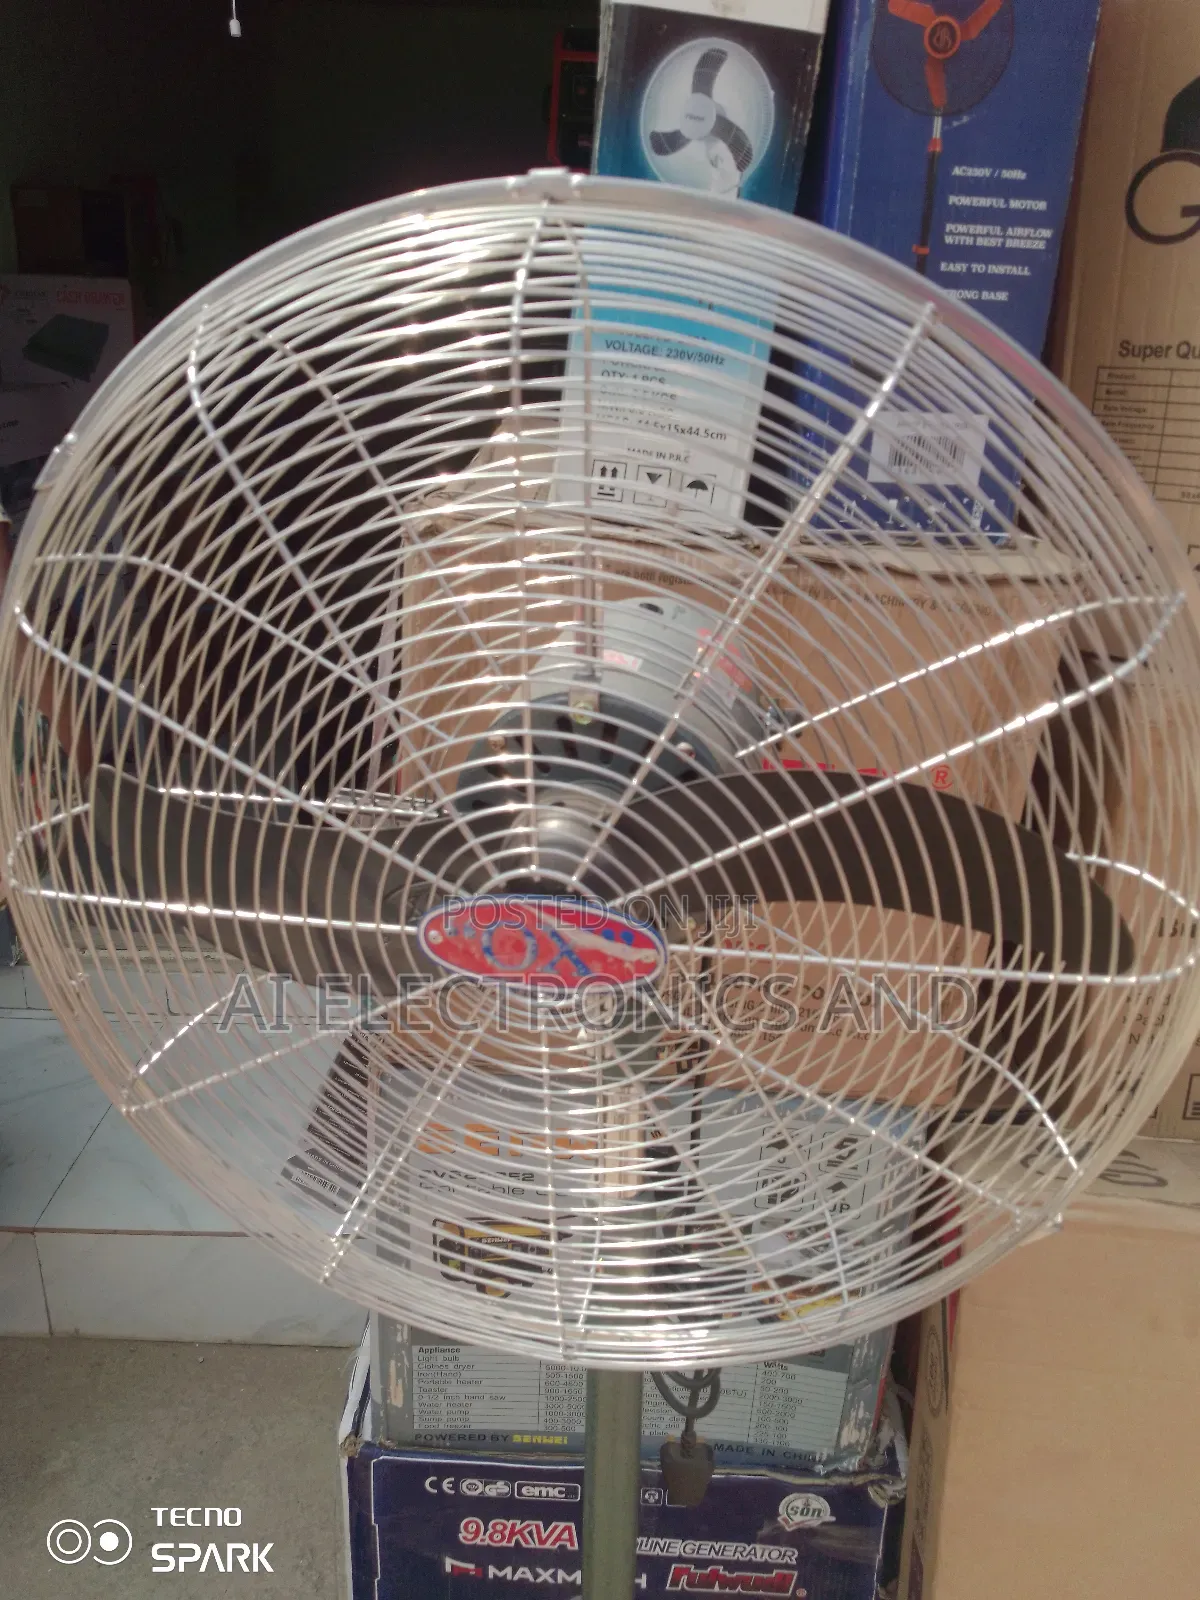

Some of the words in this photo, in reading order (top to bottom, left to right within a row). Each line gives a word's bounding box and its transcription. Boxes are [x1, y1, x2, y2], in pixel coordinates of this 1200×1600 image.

[1001, 169, 1027, 180] 50Hz
[948, 195, 1007, 209] POWERFUL
[1009, 199, 1048, 211] MOTOR
[946, 223, 1003, 236] POWERFUL
[1006, 227, 1054, 239] AIRFLOW
[944, 235, 974, 246] WITH
[976, 237, 1004, 248] BEST
[1005, 238, 1046, 250] BREEZE
[940, 262, 968, 272] EASY
[971, 264, 985, 273] TO
[987, 265, 1031, 276] INSTALL
[981, 290, 1009, 301] BASE
[605, 339, 663, 356] VOLTAGE:
[666, 347, 726, 366] 230V/50Hz
[1118, 339, 1172, 362] Super
[418, 1346, 461, 1354] Appliance
[453, 1363, 475, 1371] dryer
[763, 1361, 788, 1371] Watts
[414, 1433, 487, 1442] POWERED
[490, 1434, 509, 1442] BY
[714, 1443, 754, 1453] MADE
[762, 1448, 776, 1457] IN
[521, 1485, 566, 1498] emc
[459, 1517, 579, 1550] 9.8KVA
[681, 1540, 798, 1564] GENERATOR
